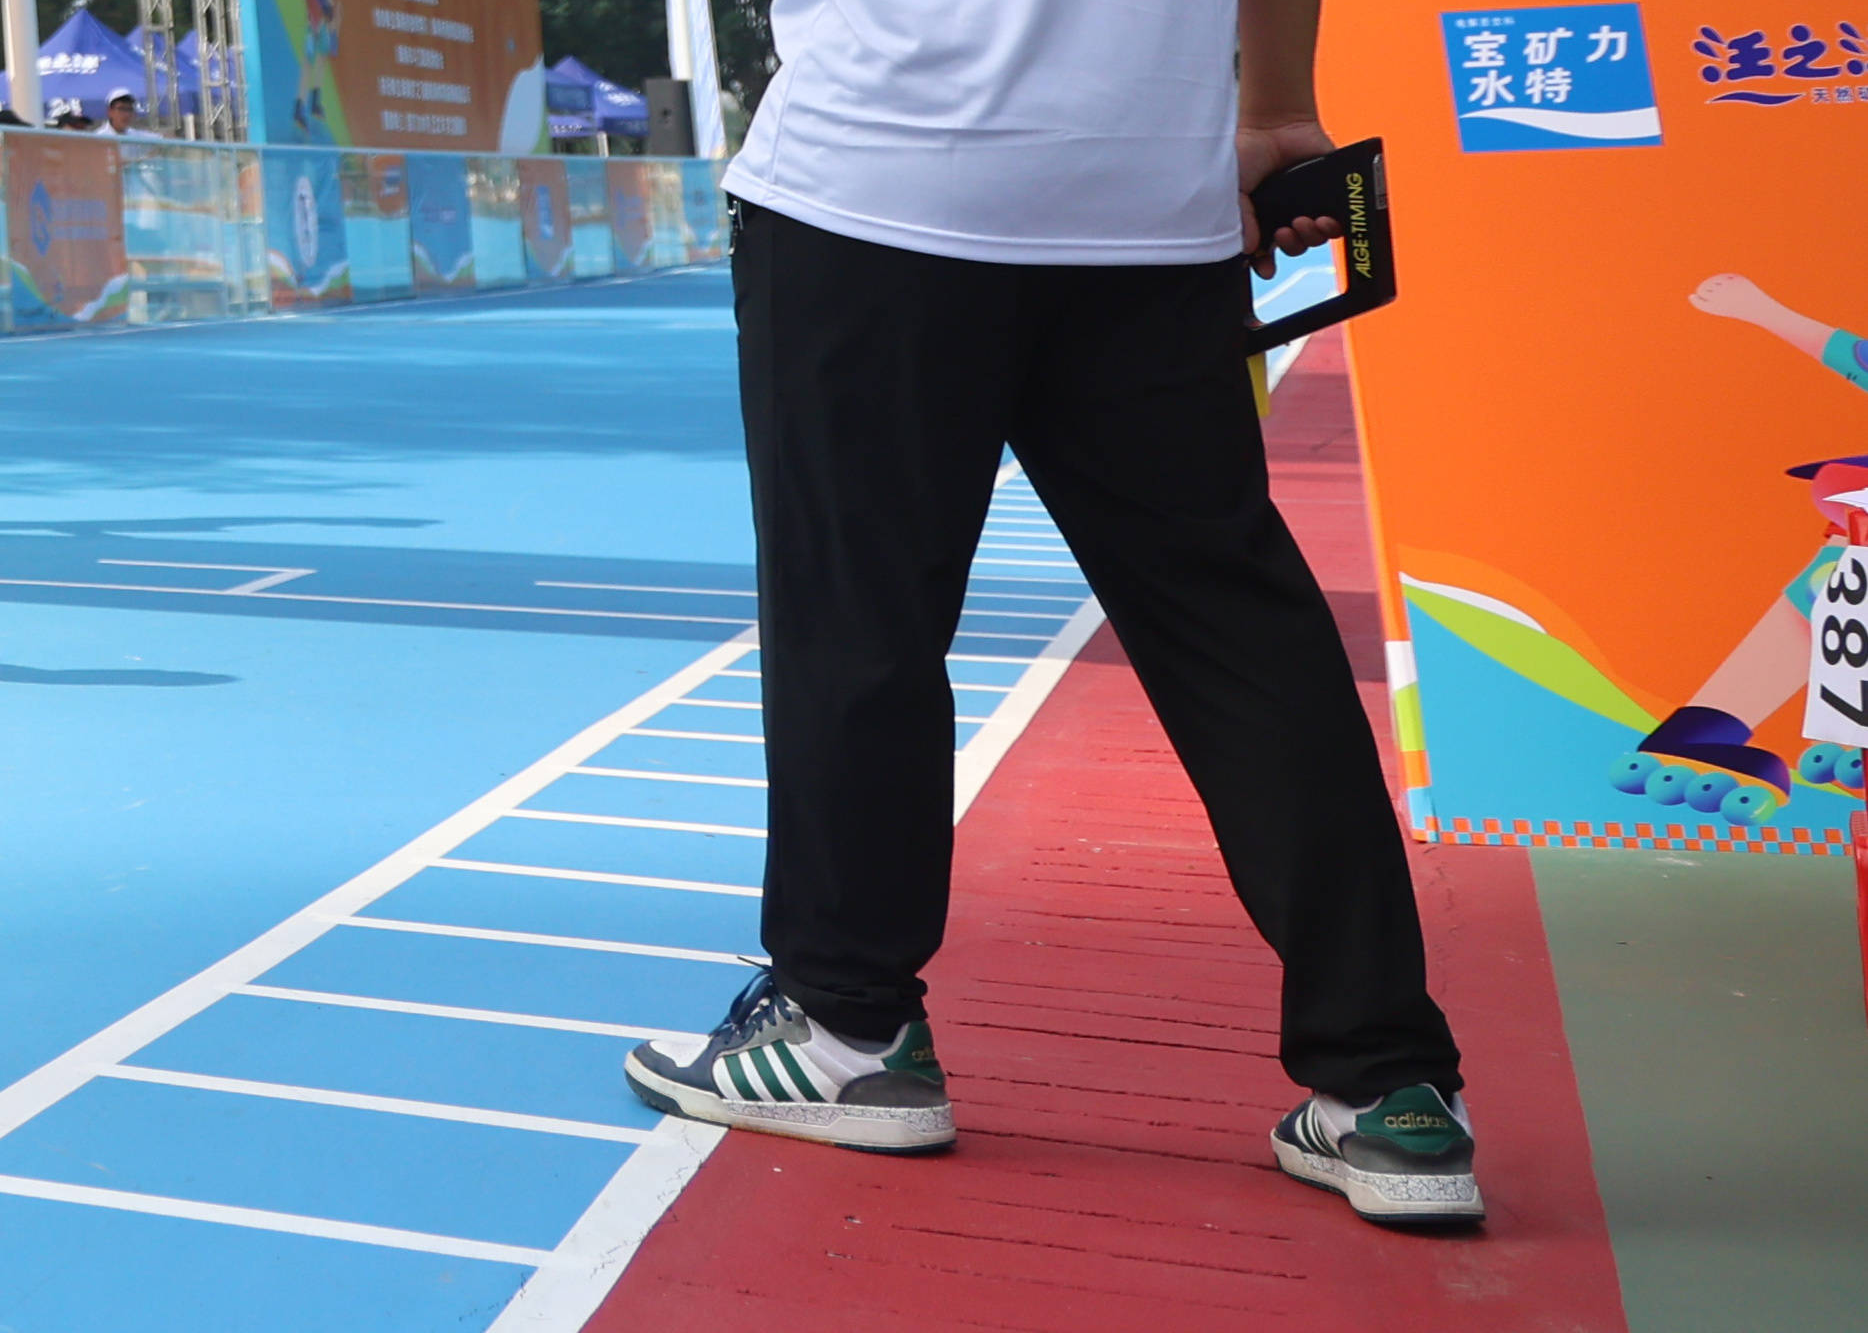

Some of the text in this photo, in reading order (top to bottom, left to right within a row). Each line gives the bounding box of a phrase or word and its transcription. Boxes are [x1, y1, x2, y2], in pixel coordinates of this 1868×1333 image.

[1462, 25, 1630, 69] 宝矿力
[1467, 66, 1574, 107] 水特
[1383, 1110, 1449, 1131] adidas
